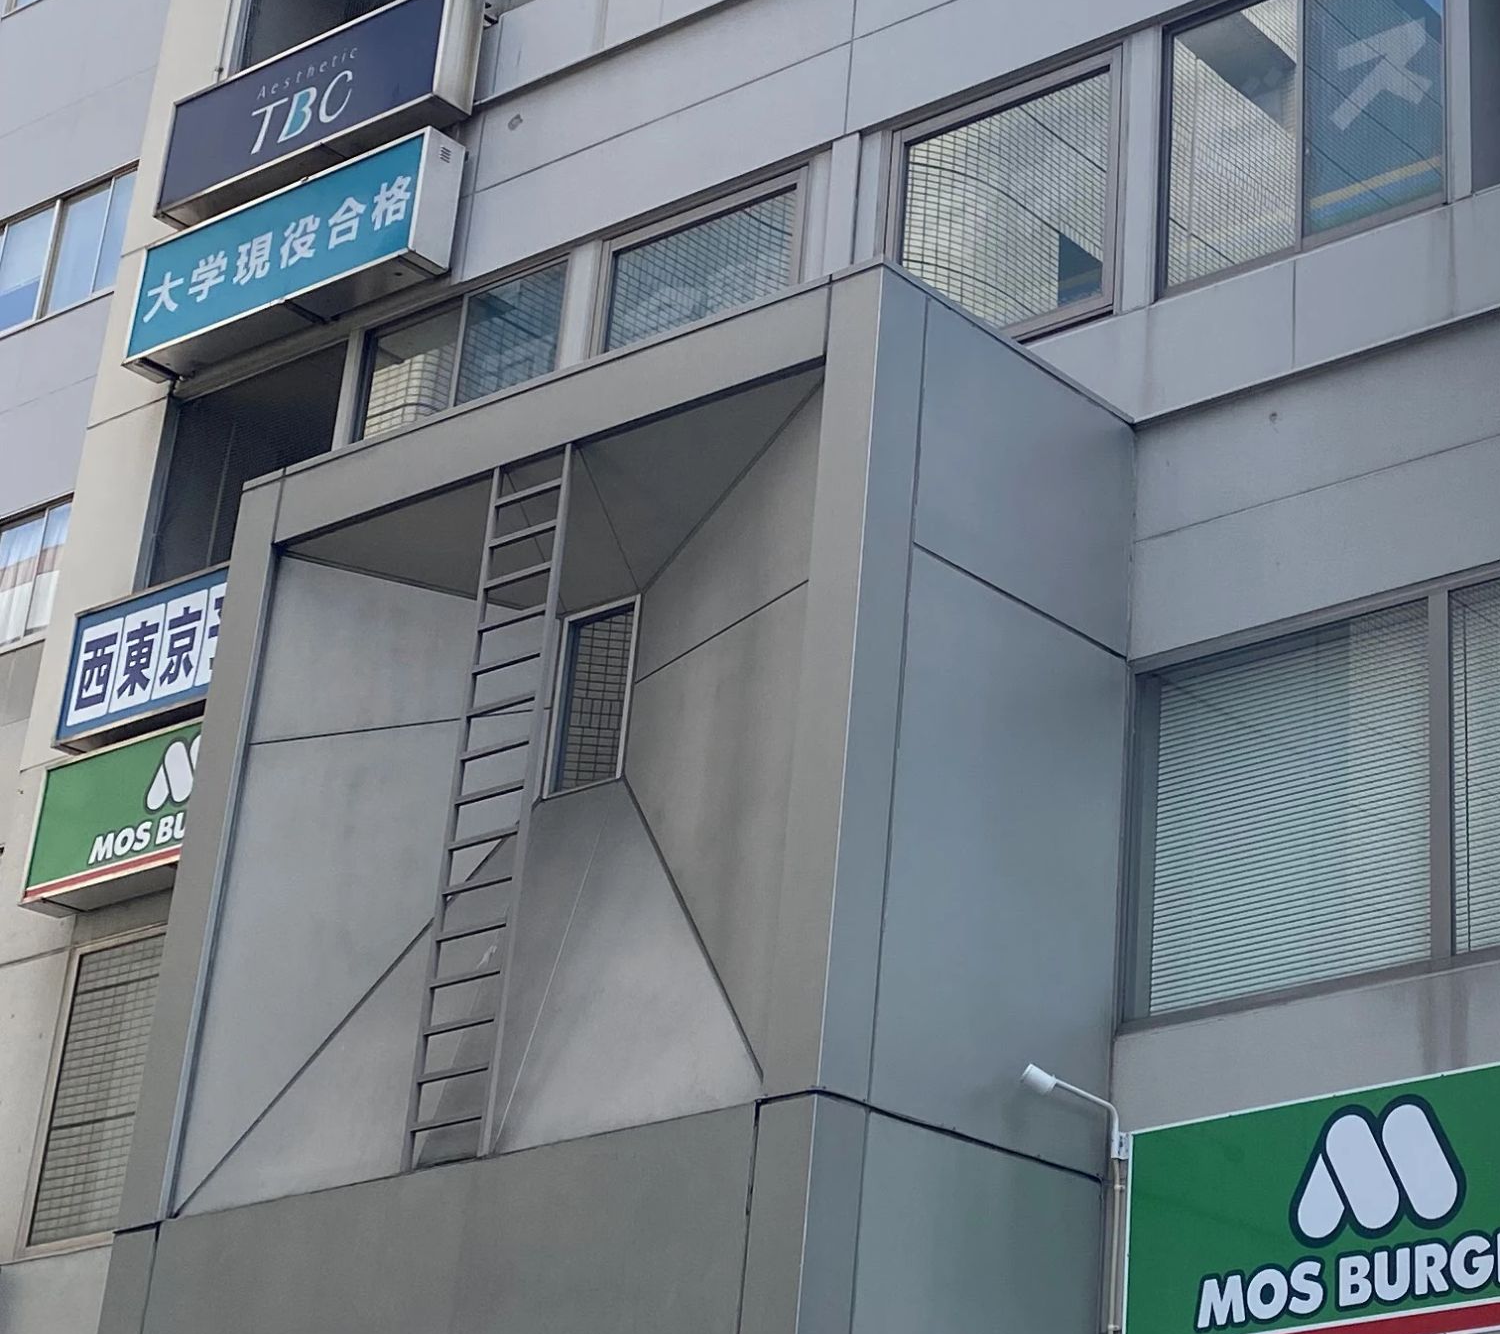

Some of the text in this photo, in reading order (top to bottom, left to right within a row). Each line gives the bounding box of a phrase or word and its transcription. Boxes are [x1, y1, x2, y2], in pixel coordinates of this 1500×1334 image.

[256, 45, 359, 100] Aesthetic
[250, 69, 354, 155] TBC
[142, 174, 413, 323] 大学現役合格
[87, 820, 153, 865] MOS
[1196, 1260, 1325, 1329] MOS
